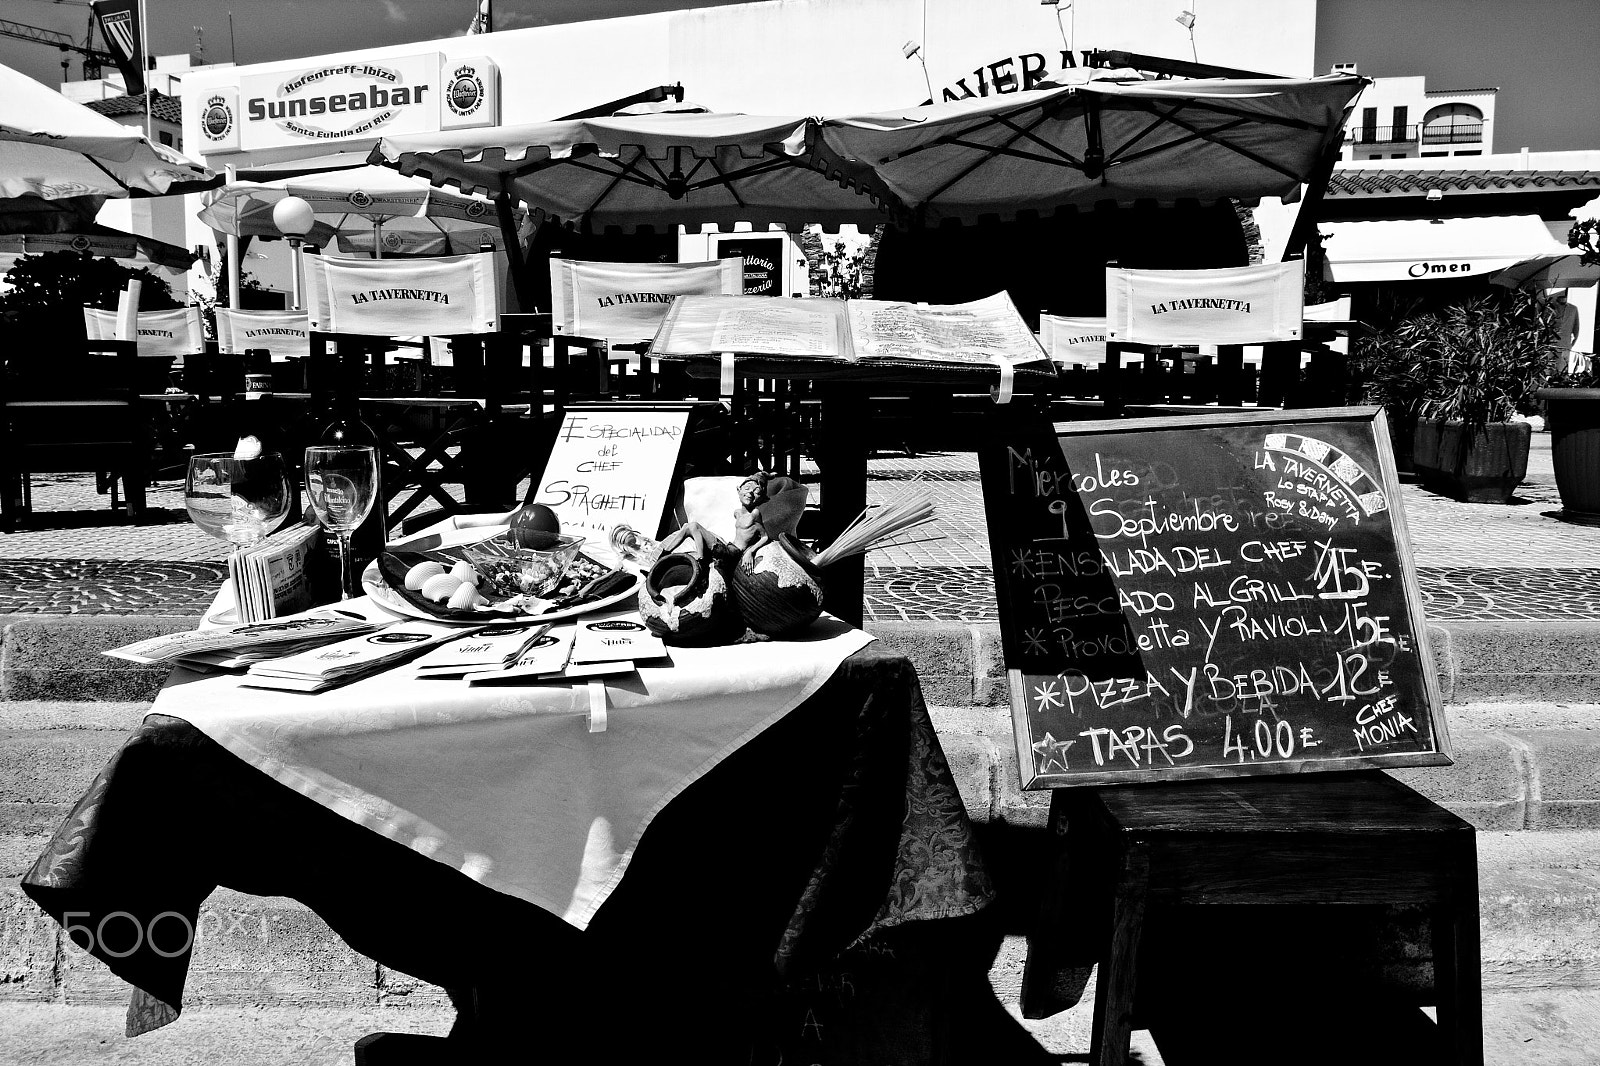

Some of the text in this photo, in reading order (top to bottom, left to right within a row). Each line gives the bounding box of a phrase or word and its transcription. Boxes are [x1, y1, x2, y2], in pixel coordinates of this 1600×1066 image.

[284, 64, 396, 94] Hafentreff-Ibiza
[248, 84, 429, 121] Sunseabar
[286, 121, 315, 137] Santa
[355, 122, 373, 134] del
[1408, 262, 1471, 278] Omen
[351, 289, 449, 305] LA TAVERNETTA
[597, 296, 615, 308] LA
[1151, 298, 1251, 315] LA TAVERNETTA
[245, 327, 306, 338] LA TAVERNETTA
[560, 416, 682, 443] ESPECIALIDAD
[576, 461, 624, 473] CHEF
[1006, 446, 1139, 498] Miércoles
[1254, 451, 1276, 471] LA
[1283, 456, 1360, 526] TAVERNETTA
[1278, 476, 1294, 490] LO
[1263, 491, 1296, 514] Rosy
[1089, 495, 1240, 549] Septiembre
[1035, 546, 1176, 579] ENSALADA
[1171, 547, 1232, 573] DEL
[1240, 540, 1307, 562] CHEF
[1034, 583, 1175, 623] PESCADO
[1193, 582, 1232, 609] AL
[1228, 575, 1315, 603] GRILL
[1221, 605, 1328, 642] RAVIOLI
[1057, 668, 1170, 714] PIZZA
[1203, 663, 1321, 701] BEBIDA
[1355, 694, 1398, 725] CHEF
[1352, 711, 1418, 752] MONIA
[1078, 725, 1194, 769] TAPAS
